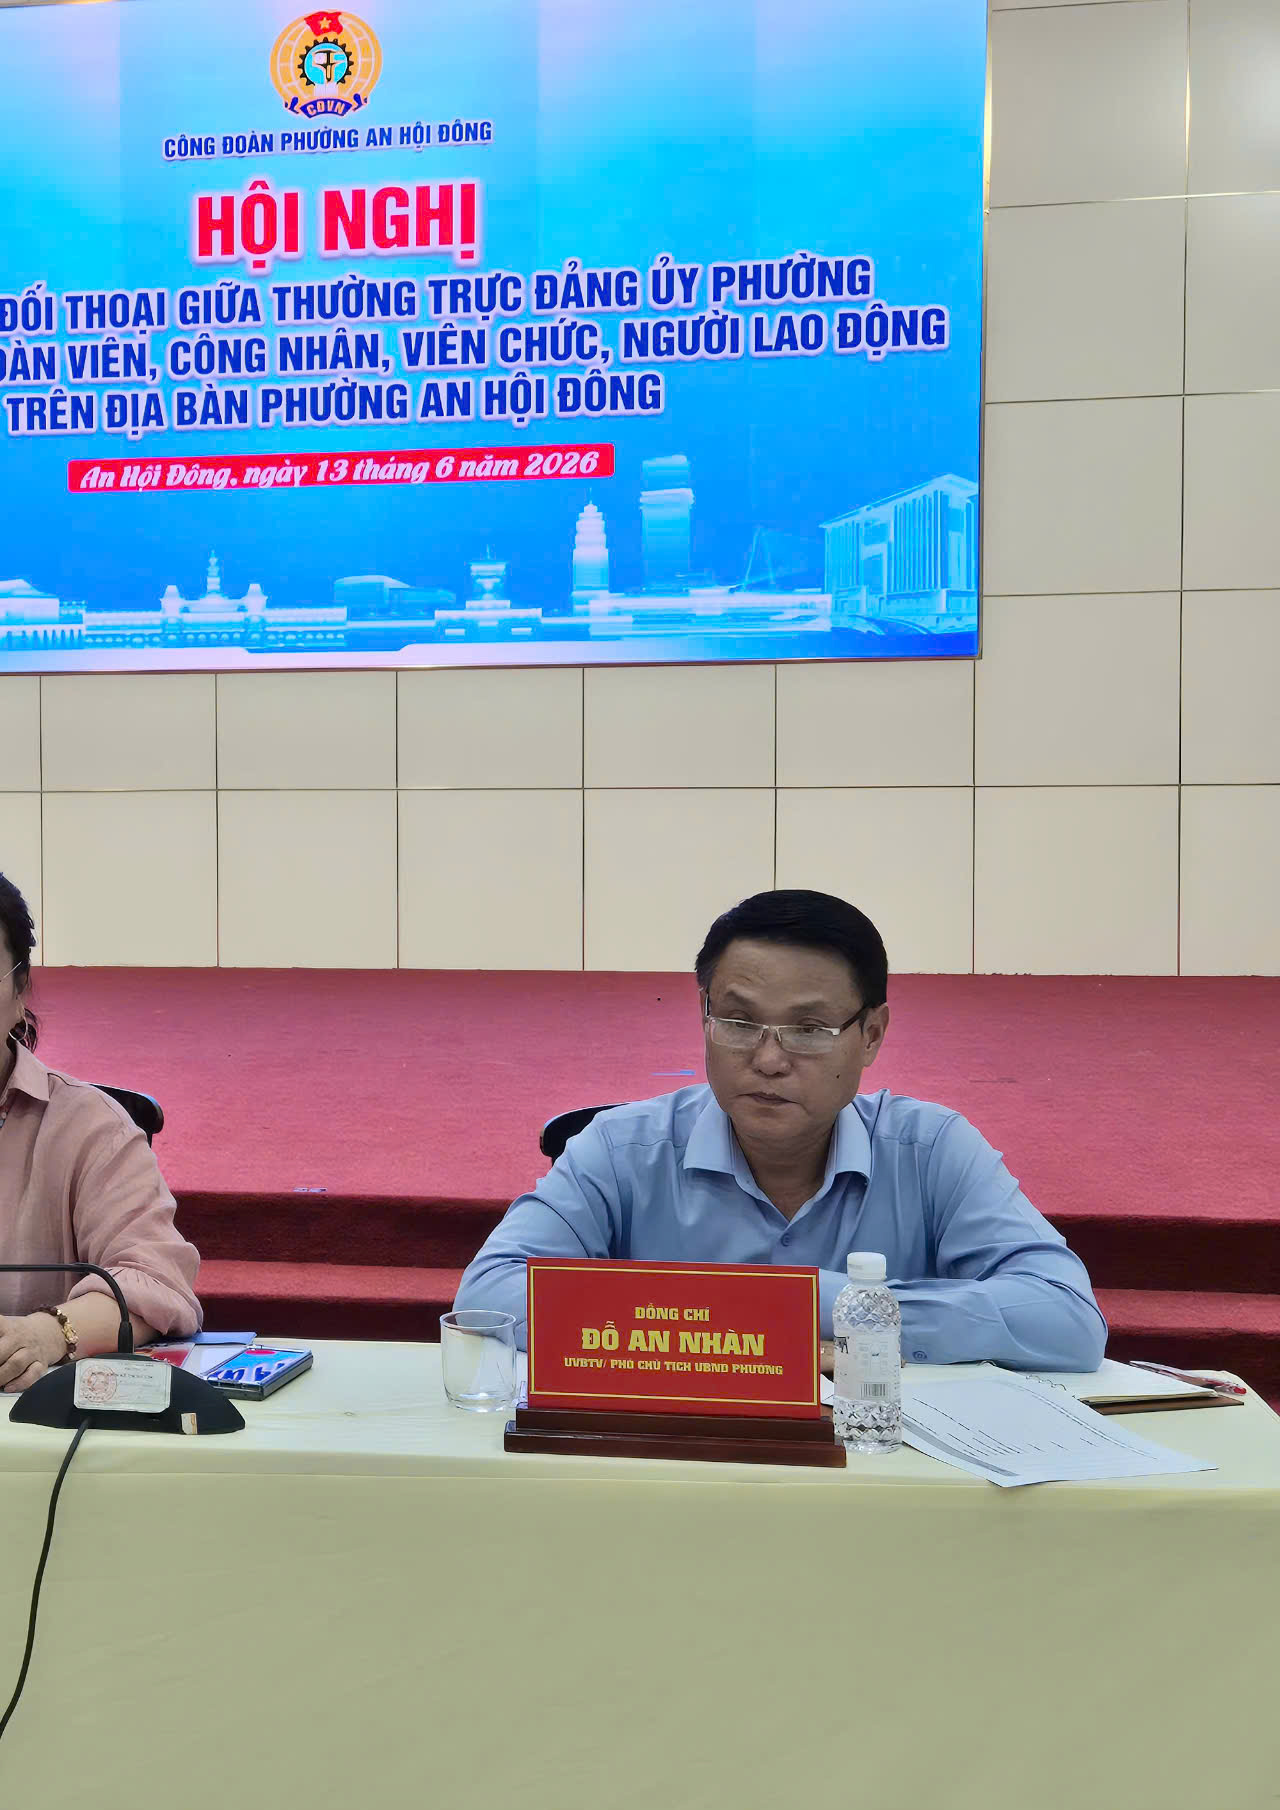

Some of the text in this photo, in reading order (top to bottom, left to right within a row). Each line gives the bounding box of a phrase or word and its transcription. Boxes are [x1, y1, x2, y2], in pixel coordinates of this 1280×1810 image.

[164, 119, 492, 158] CÔNG ĐOÀN PHƯỜNG AN HỘI ĐÔNG
[198, 180, 476, 269] HỘI NGHỊ
[65, 293, 165, 335] THOẠI
[179, 281, 262, 326] GIỮA
[272, 274, 416, 321] THƯỜNG
[428, 272, 522, 321] TRỰC
[535, 261, 638, 310] ĐẢNG
[652, 256, 699, 305] ỦY
[712, 253, 871, 302] PHƯỜNG
[68, 337, 157, 381] VIÊN,
[170, 333, 266, 374] CÔNG
[278, 327, 390, 373] NHÂN,
[403, 323, 486, 367] VIÊN
[499, 312, 609, 364] CHỨC,
[624, 310, 739, 359] NGƯỜI
[754, 313, 820, 352] LAO
[837, 304, 946, 356] ĐỘNG
[6, 369, 661, 435] TRÊN ĐỊA BÀN PHƯỜNG AN HỘI ĐÔNG
[80, 466, 115, 488] An
[119, 463, 162, 492] Hội
[243, 459, 308, 488] ngày
[316, 459, 349, 482] 13
[353, 456, 431, 484] tháng
[435, 456, 455, 478] 6
[458, 455, 520, 478] năm
[523, 451, 600, 476] 2026
[581, 1320, 765, 1357] ĐỖ AN NHÀN
